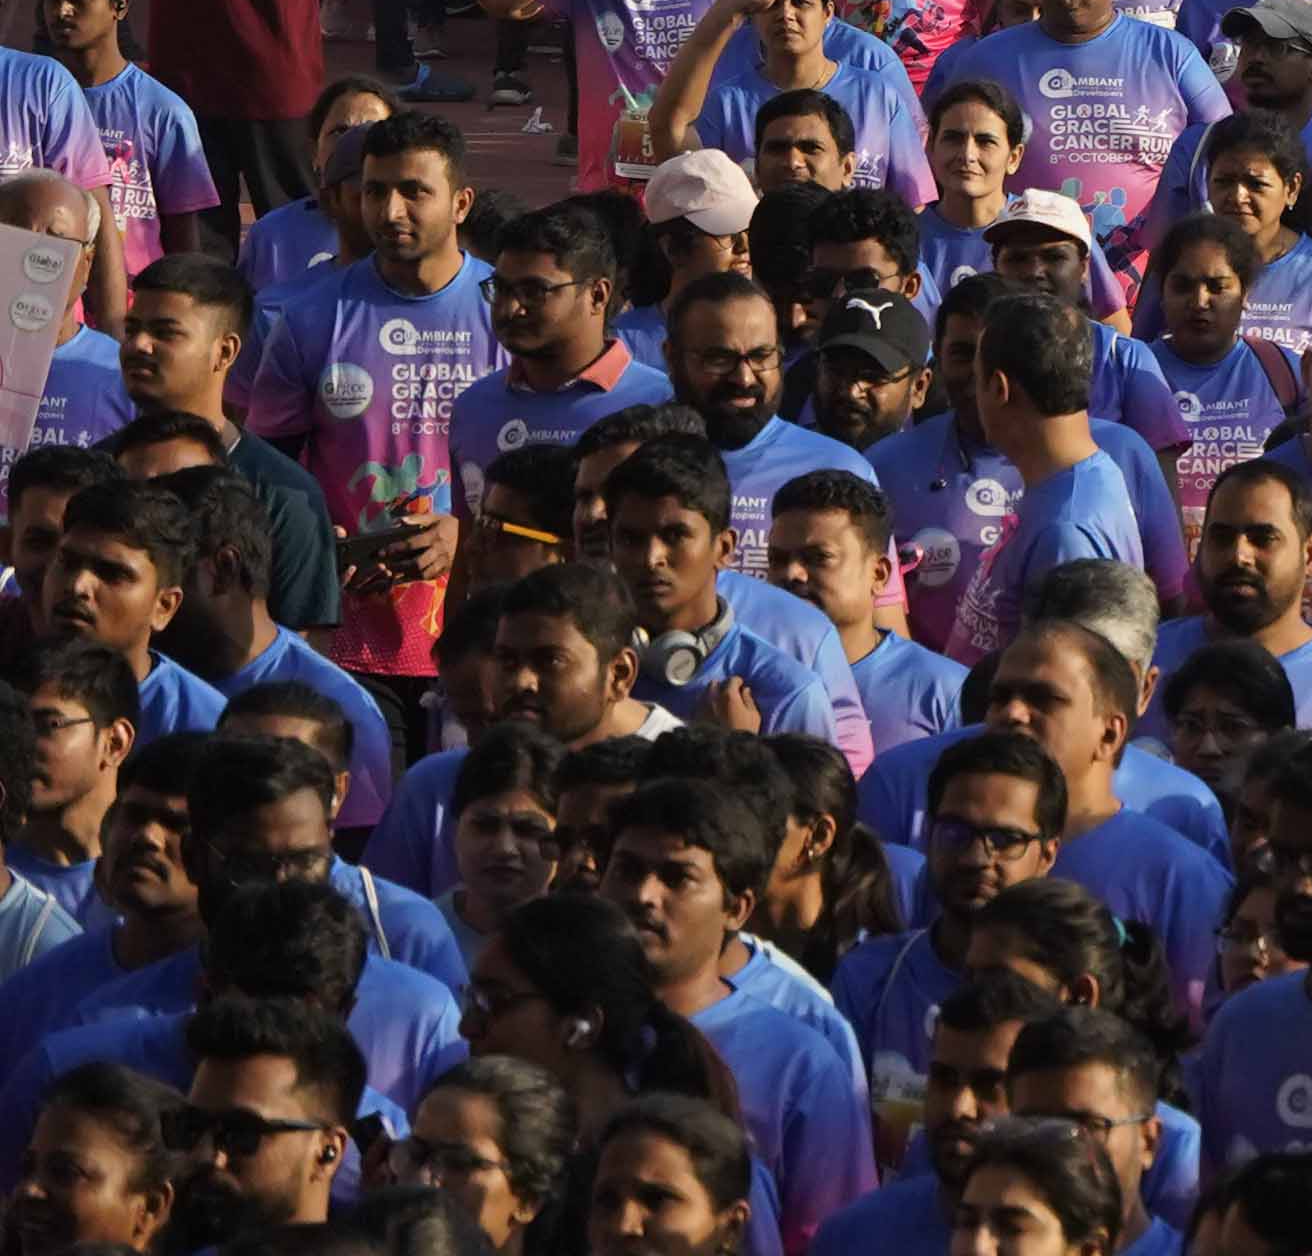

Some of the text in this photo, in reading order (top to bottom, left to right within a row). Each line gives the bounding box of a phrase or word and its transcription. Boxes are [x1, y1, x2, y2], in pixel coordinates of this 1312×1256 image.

[632, 13, 696, 30] GLOBAL
[1050, 103, 1130, 119] GLOBAL
[1050, 119, 1138, 135] GRACE
[1050, 134, 1173, 154] CANCER RUN
[1068, 150, 1133, 165] OCTOBER
[124, 205, 156, 219] 2023
[392, 363, 477, 382] GLOBAL
[392, 402, 451, 420] CANC
